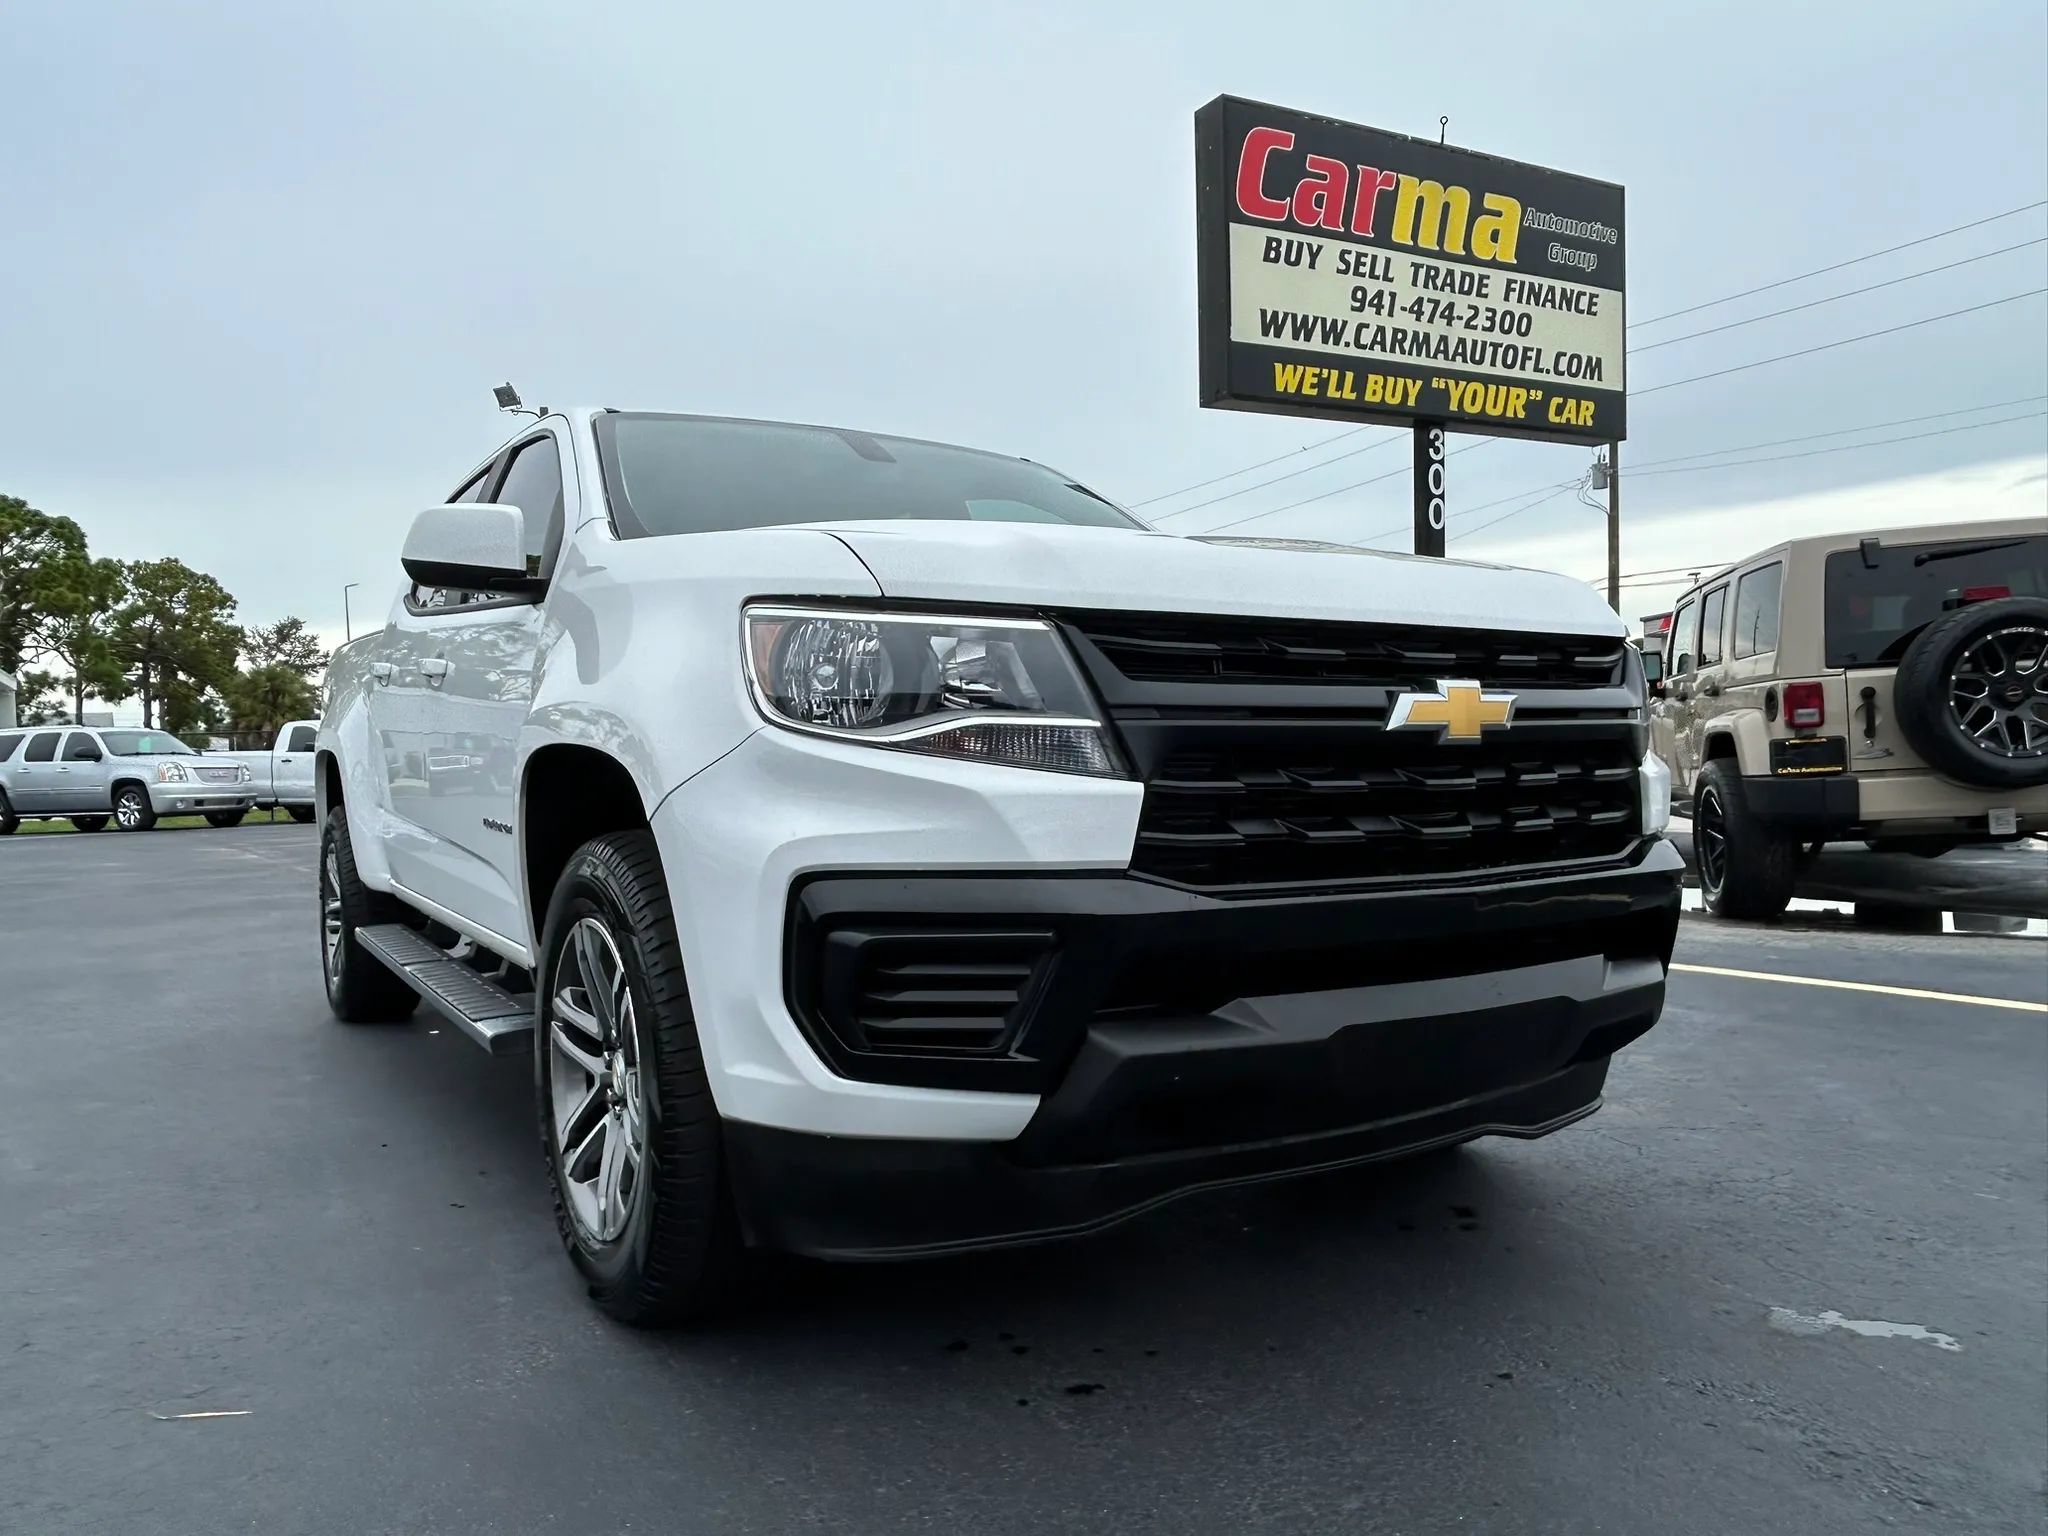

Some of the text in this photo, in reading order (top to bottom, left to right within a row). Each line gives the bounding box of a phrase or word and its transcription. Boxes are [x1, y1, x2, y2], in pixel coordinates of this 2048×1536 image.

[1236, 126, 1522, 264] Carma
[1523, 207, 1618, 244] Automotive
[1262, 235, 1600, 317] BUY SELL TRADE FINANCE
[1548, 242, 1598, 272] Group
[1259, 308, 1603, 382] WWW.CARMAAUTOFL.COM
[1350, 285, 1533, 338] 941-474-2300
[1273, 362, 1357, 400] WE'LL
[1364, 373, 1423, 407] BUY
[1548, 396, 1596, 427] CAR
[1428, 428, 1445, 530] 300
